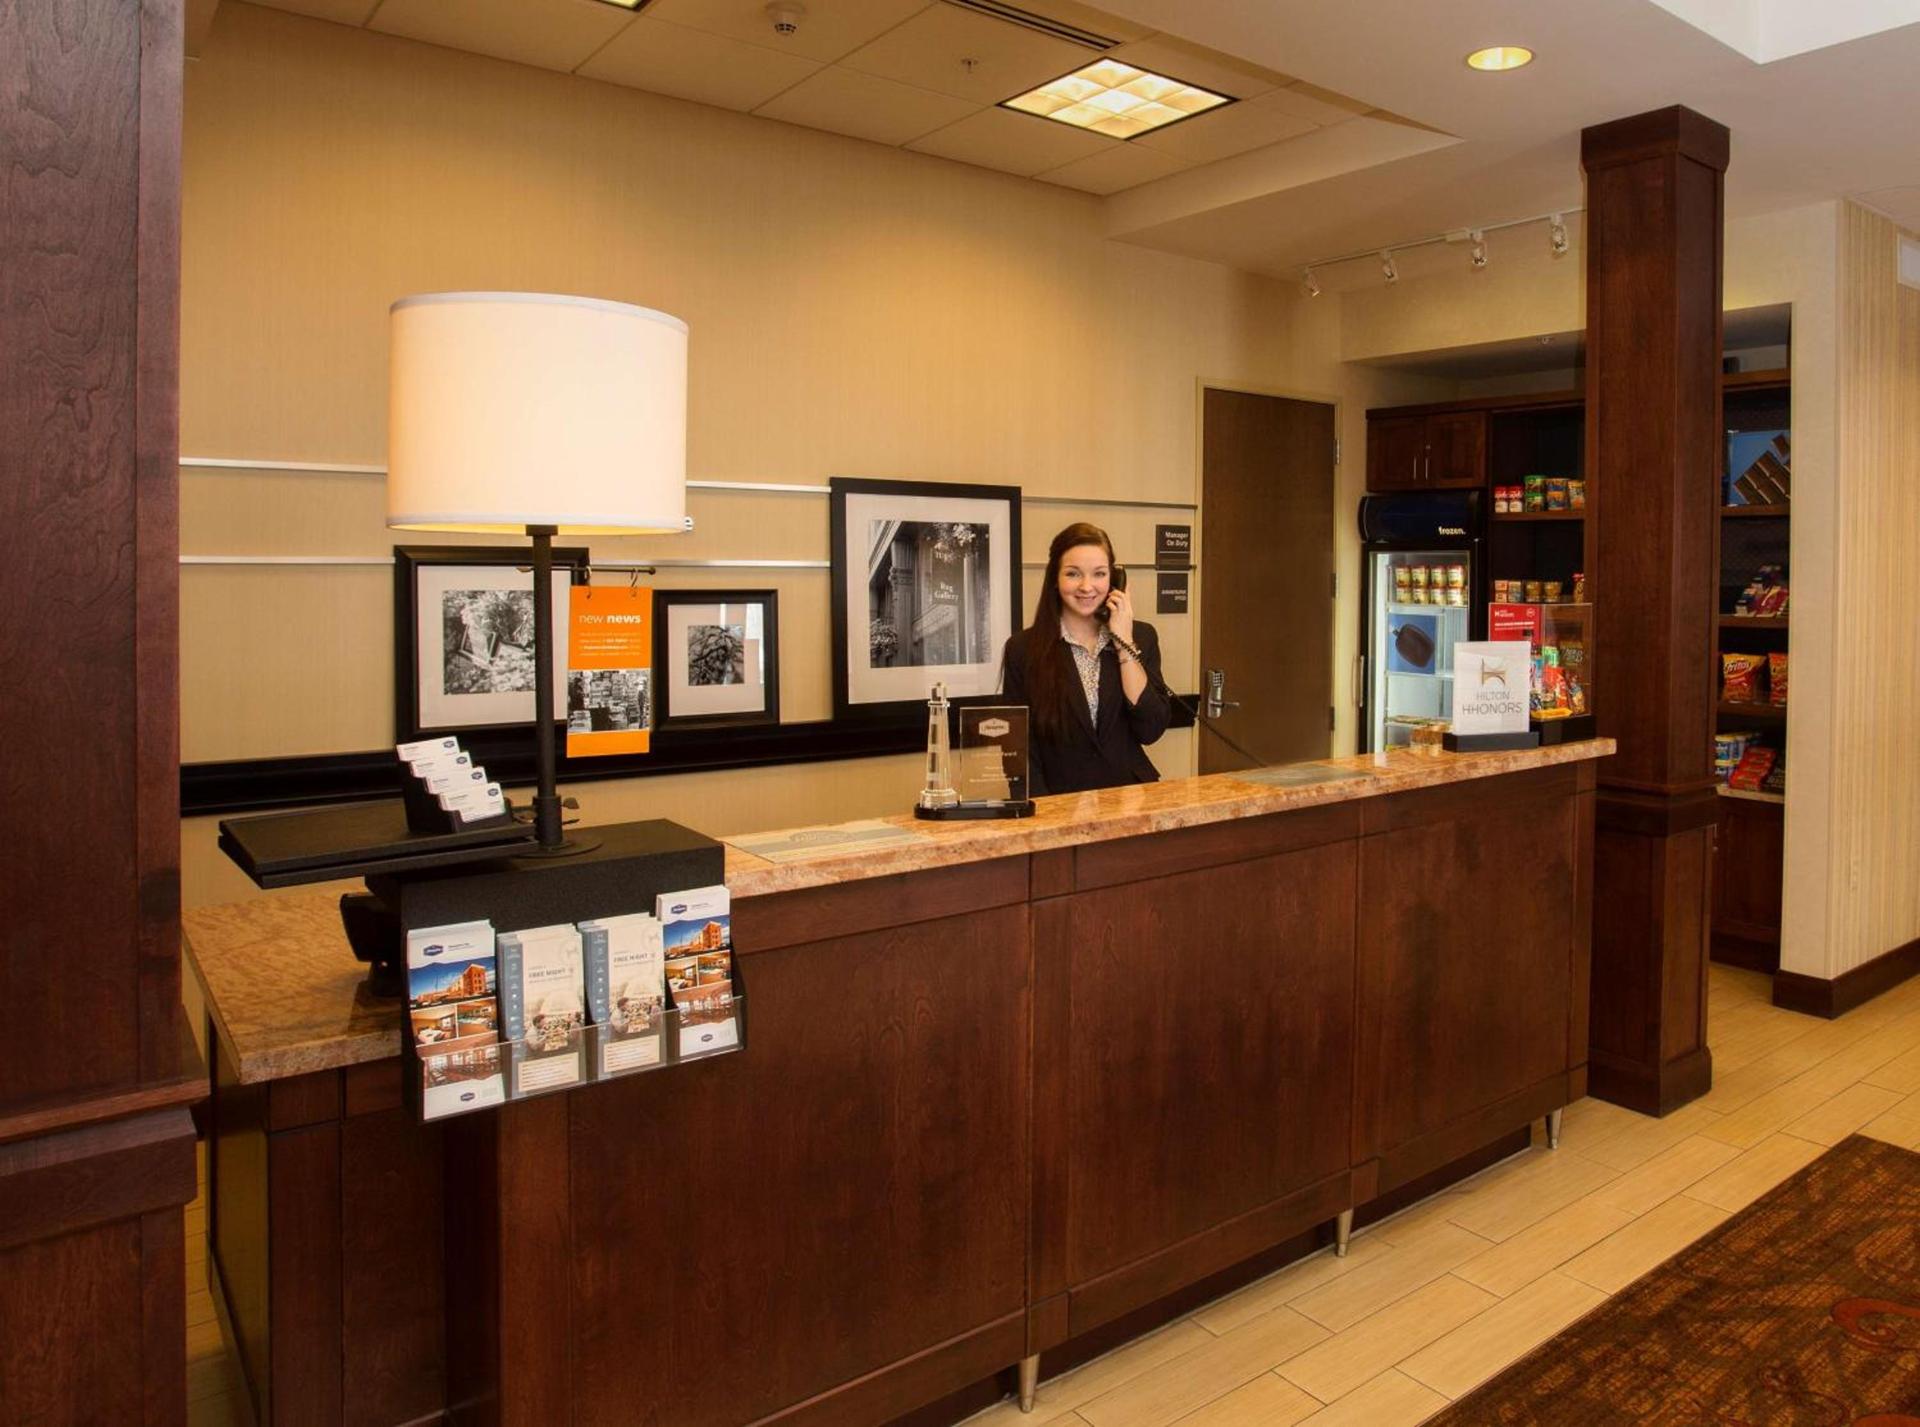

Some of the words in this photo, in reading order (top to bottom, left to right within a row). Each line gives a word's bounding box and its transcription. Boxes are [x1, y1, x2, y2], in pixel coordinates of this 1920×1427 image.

[1165, 531, 1189, 540] Manager
[579, 615, 604, 624] new
[606, 614, 642, 624] news
[1476, 690, 1511, 701] HILTON
[1462, 702, 1523, 715] HHONORS
